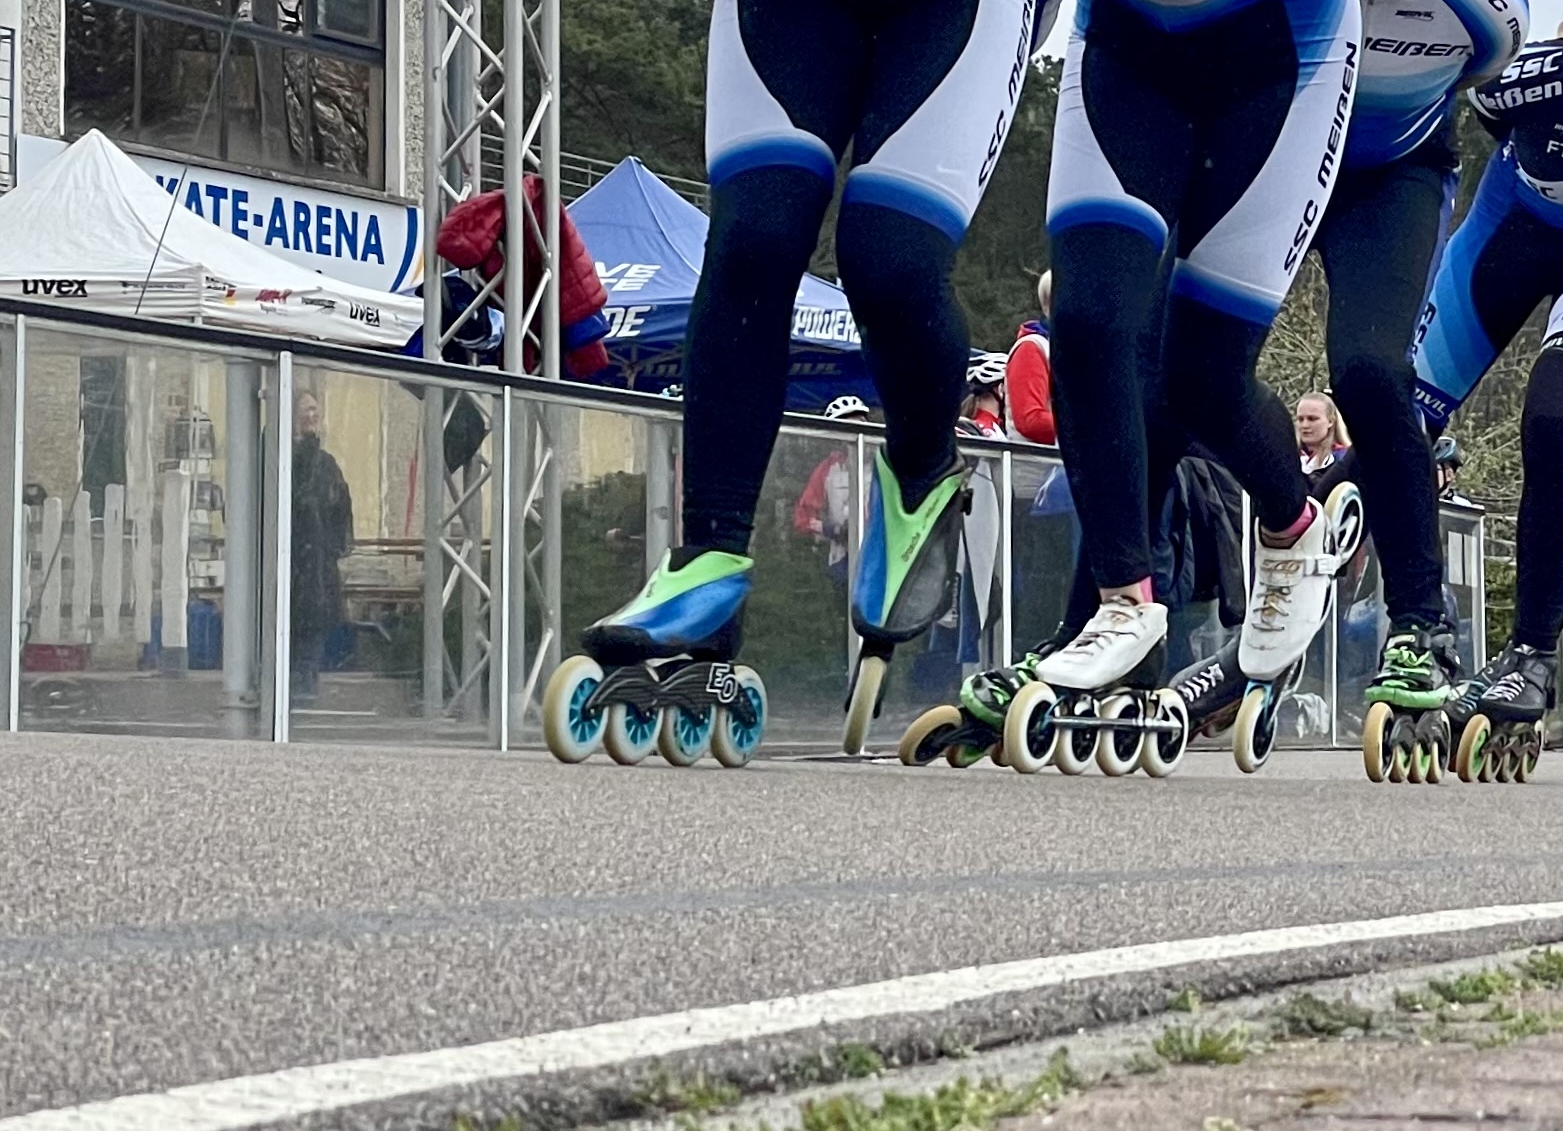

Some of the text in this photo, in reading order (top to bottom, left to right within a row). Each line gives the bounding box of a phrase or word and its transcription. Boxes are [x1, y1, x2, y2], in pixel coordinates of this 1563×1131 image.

[1500, 51, 1563, 85] SSC
[1284, 199, 1318, 275] SSC
[22, 278, 88, 297] uvex
